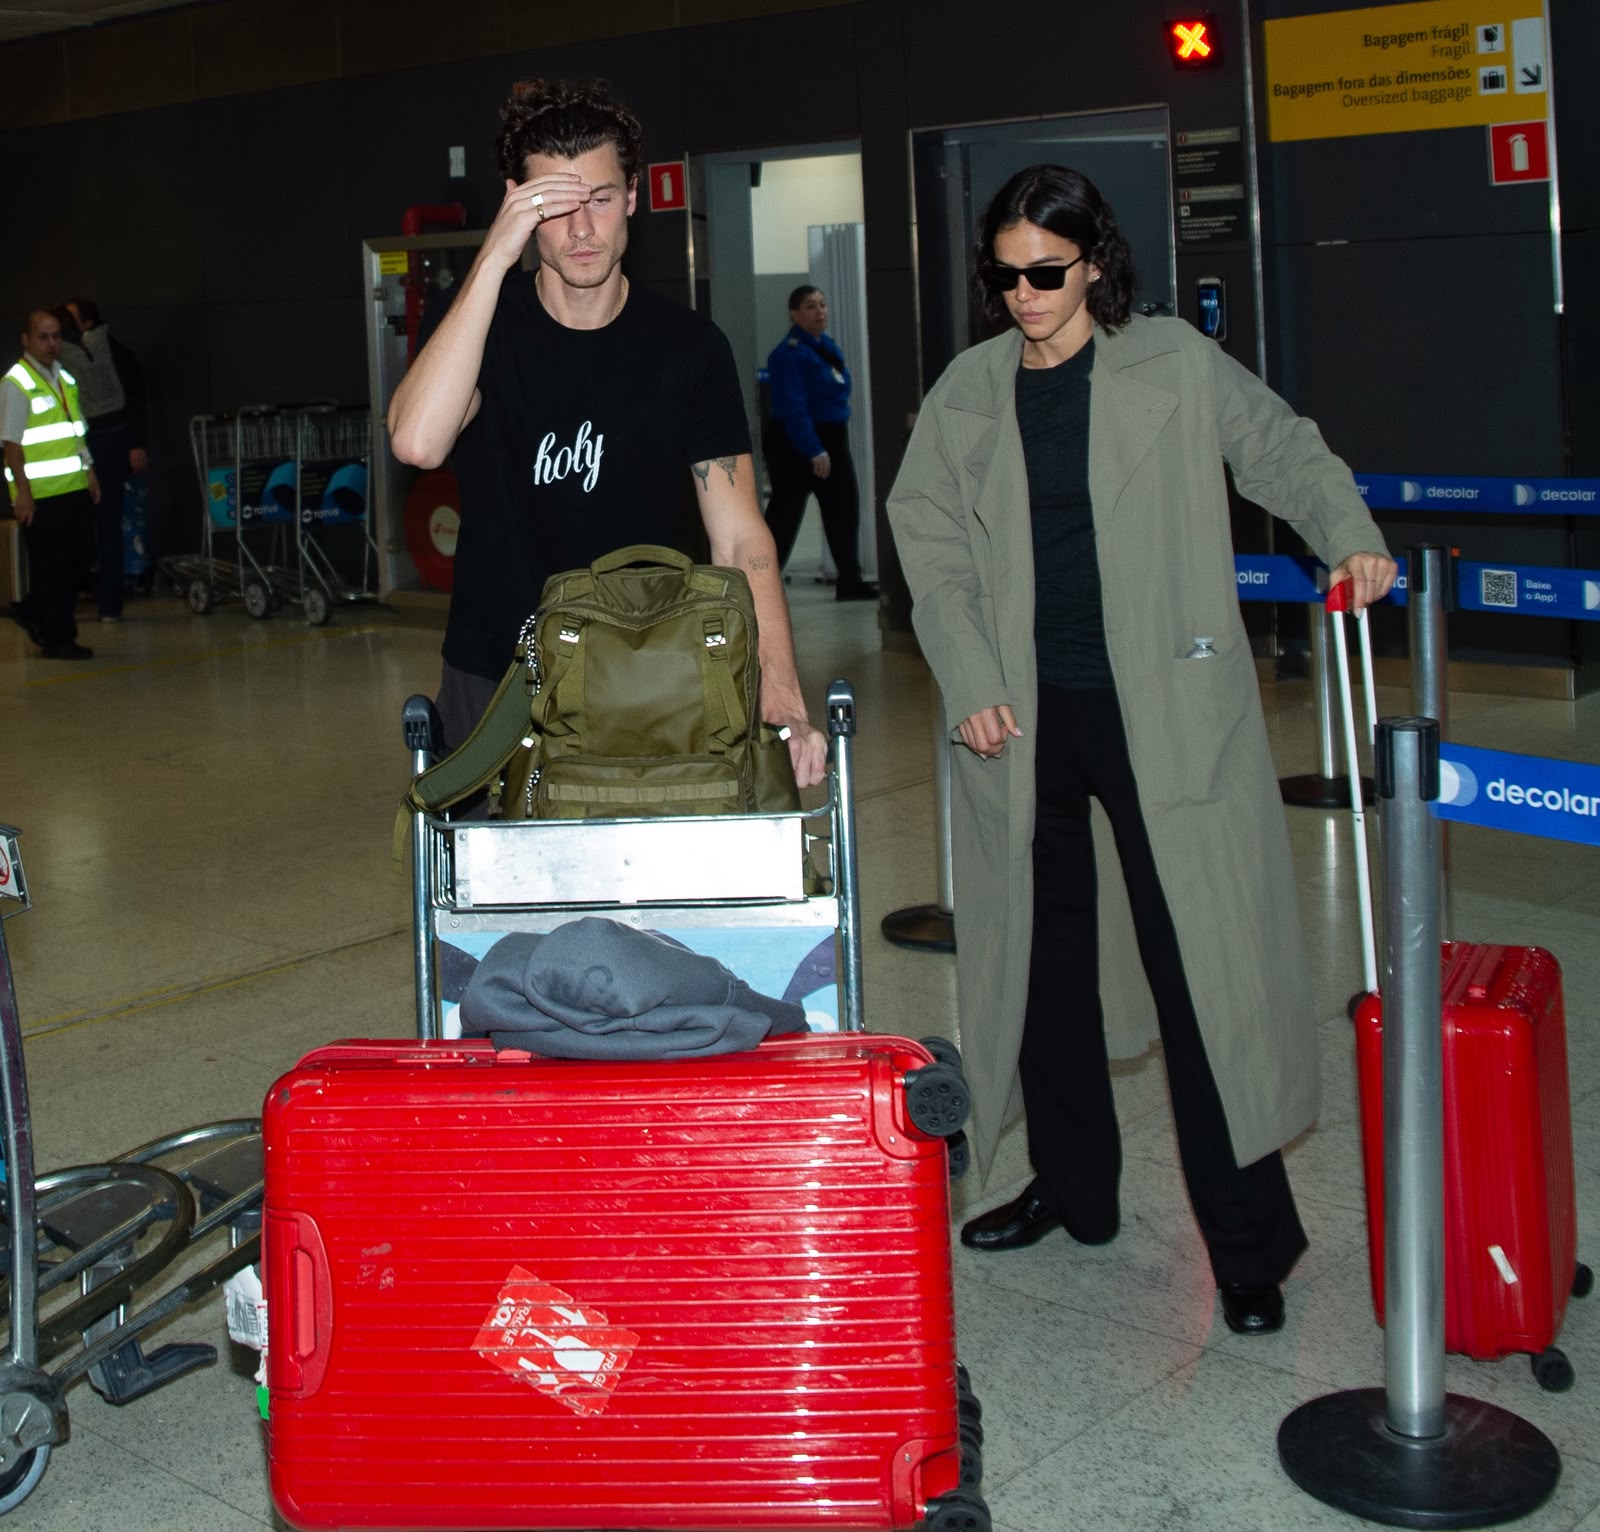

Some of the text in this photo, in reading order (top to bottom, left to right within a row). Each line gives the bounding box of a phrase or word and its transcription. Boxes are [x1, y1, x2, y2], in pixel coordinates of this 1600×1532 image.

[1363, 23, 1469, 49] Bagagem frágil
[1432, 42, 1470, 60] Fragil
[1273, 66, 1472, 99] Bagagem fora das dimensões
[1343, 85, 1472, 107] Oversized baggage
[533, 420, 605, 493] holy
[1427, 485, 1480, 500] decolar
[1540, 488, 1597, 502] decolar
[1534, 592, 1558, 604] App!
[1486, 778, 1600, 816] decolar
